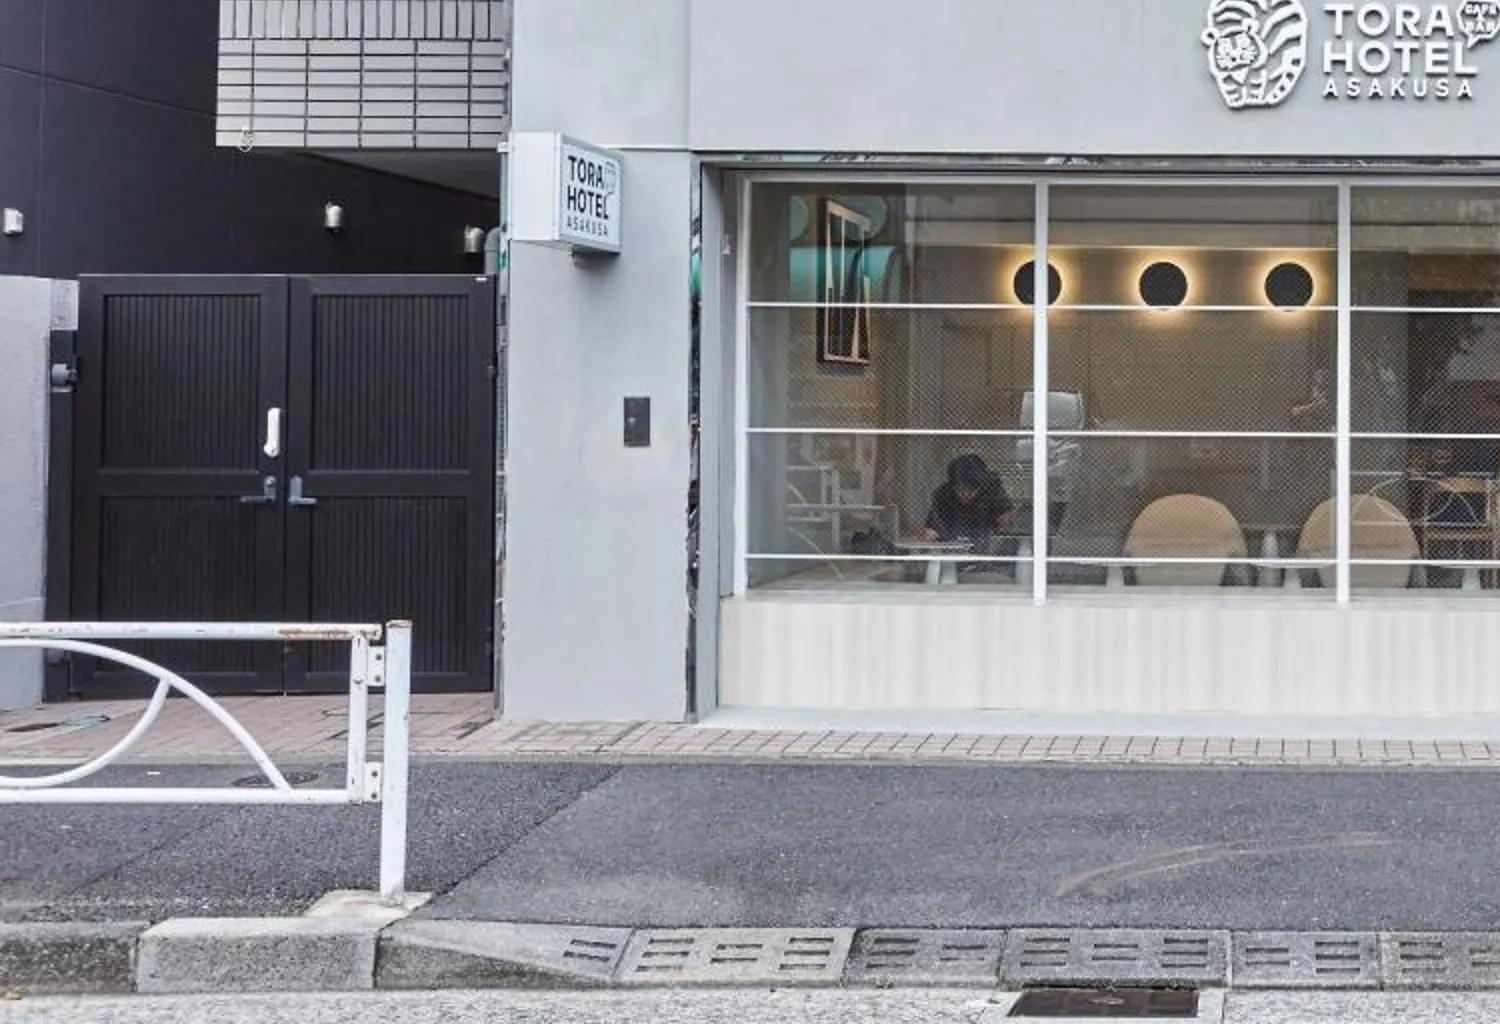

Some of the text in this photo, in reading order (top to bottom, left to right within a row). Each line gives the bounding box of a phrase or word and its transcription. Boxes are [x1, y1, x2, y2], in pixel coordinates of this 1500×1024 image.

[1323, 3, 1454, 37] TORA
[1323, 40, 1479, 75] HOTEL
[1322, 77, 1473, 98] ASAKUSA
[567, 155, 605, 189] TORA
[567, 185, 609, 220] HOTEL
